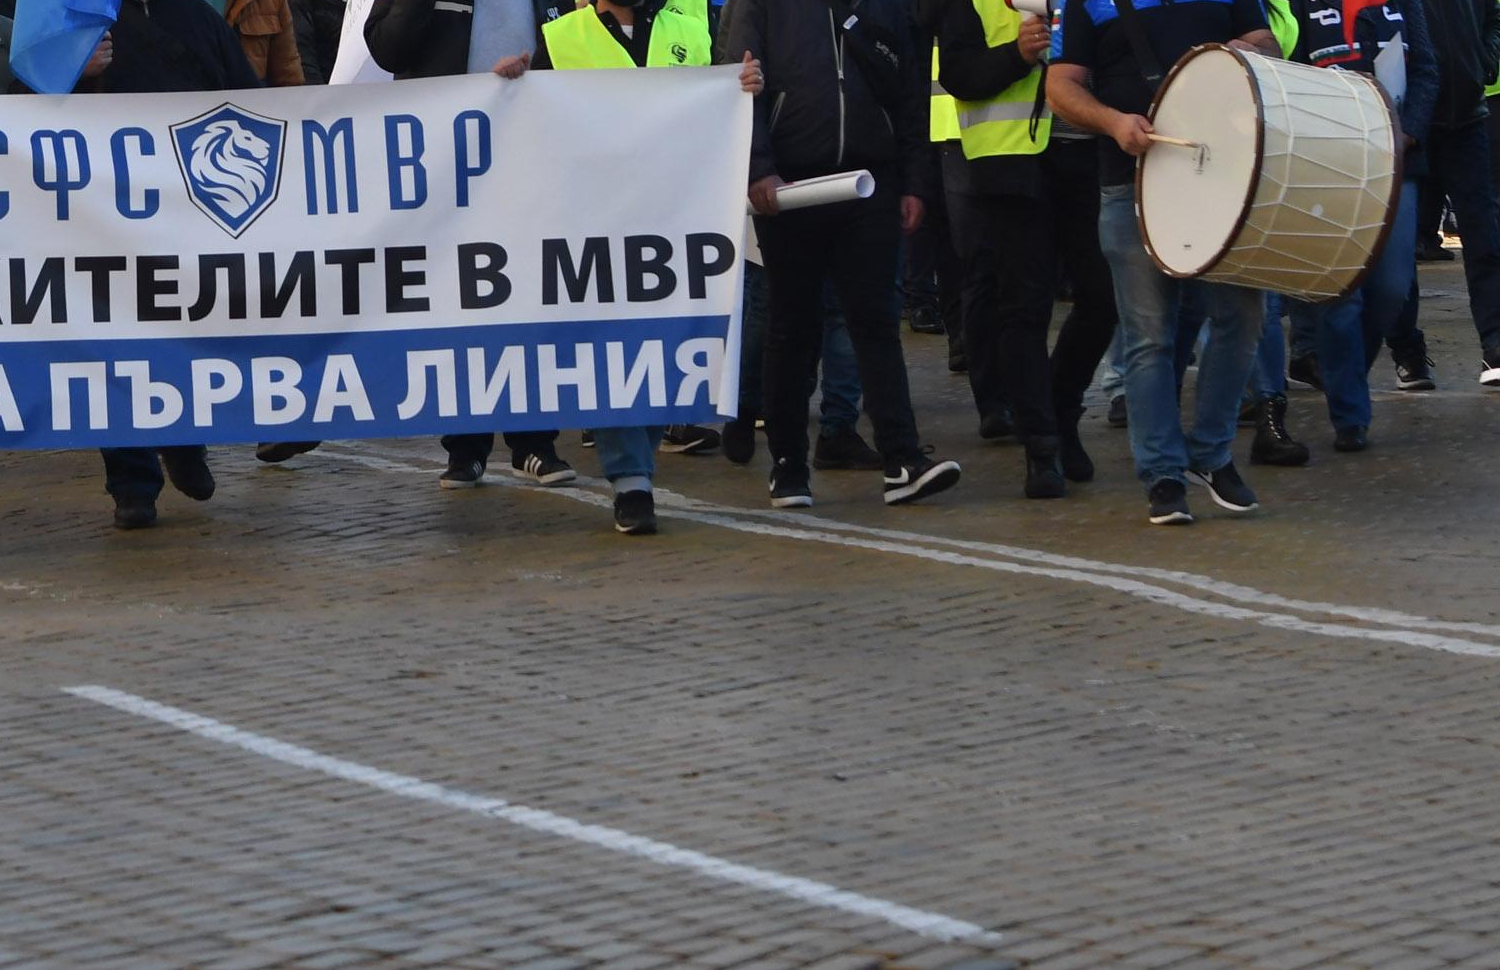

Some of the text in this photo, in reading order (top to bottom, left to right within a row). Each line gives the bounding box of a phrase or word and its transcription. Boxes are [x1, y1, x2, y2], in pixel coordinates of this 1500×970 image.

[301, 109, 492, 215] МВР
[473, 242, 513, 310] В
[542, 232, 736, 306] МВР
[50, 353, 374, 431] ПЪРВА
[398, 337, 723, 422] ЛИНИЯ
